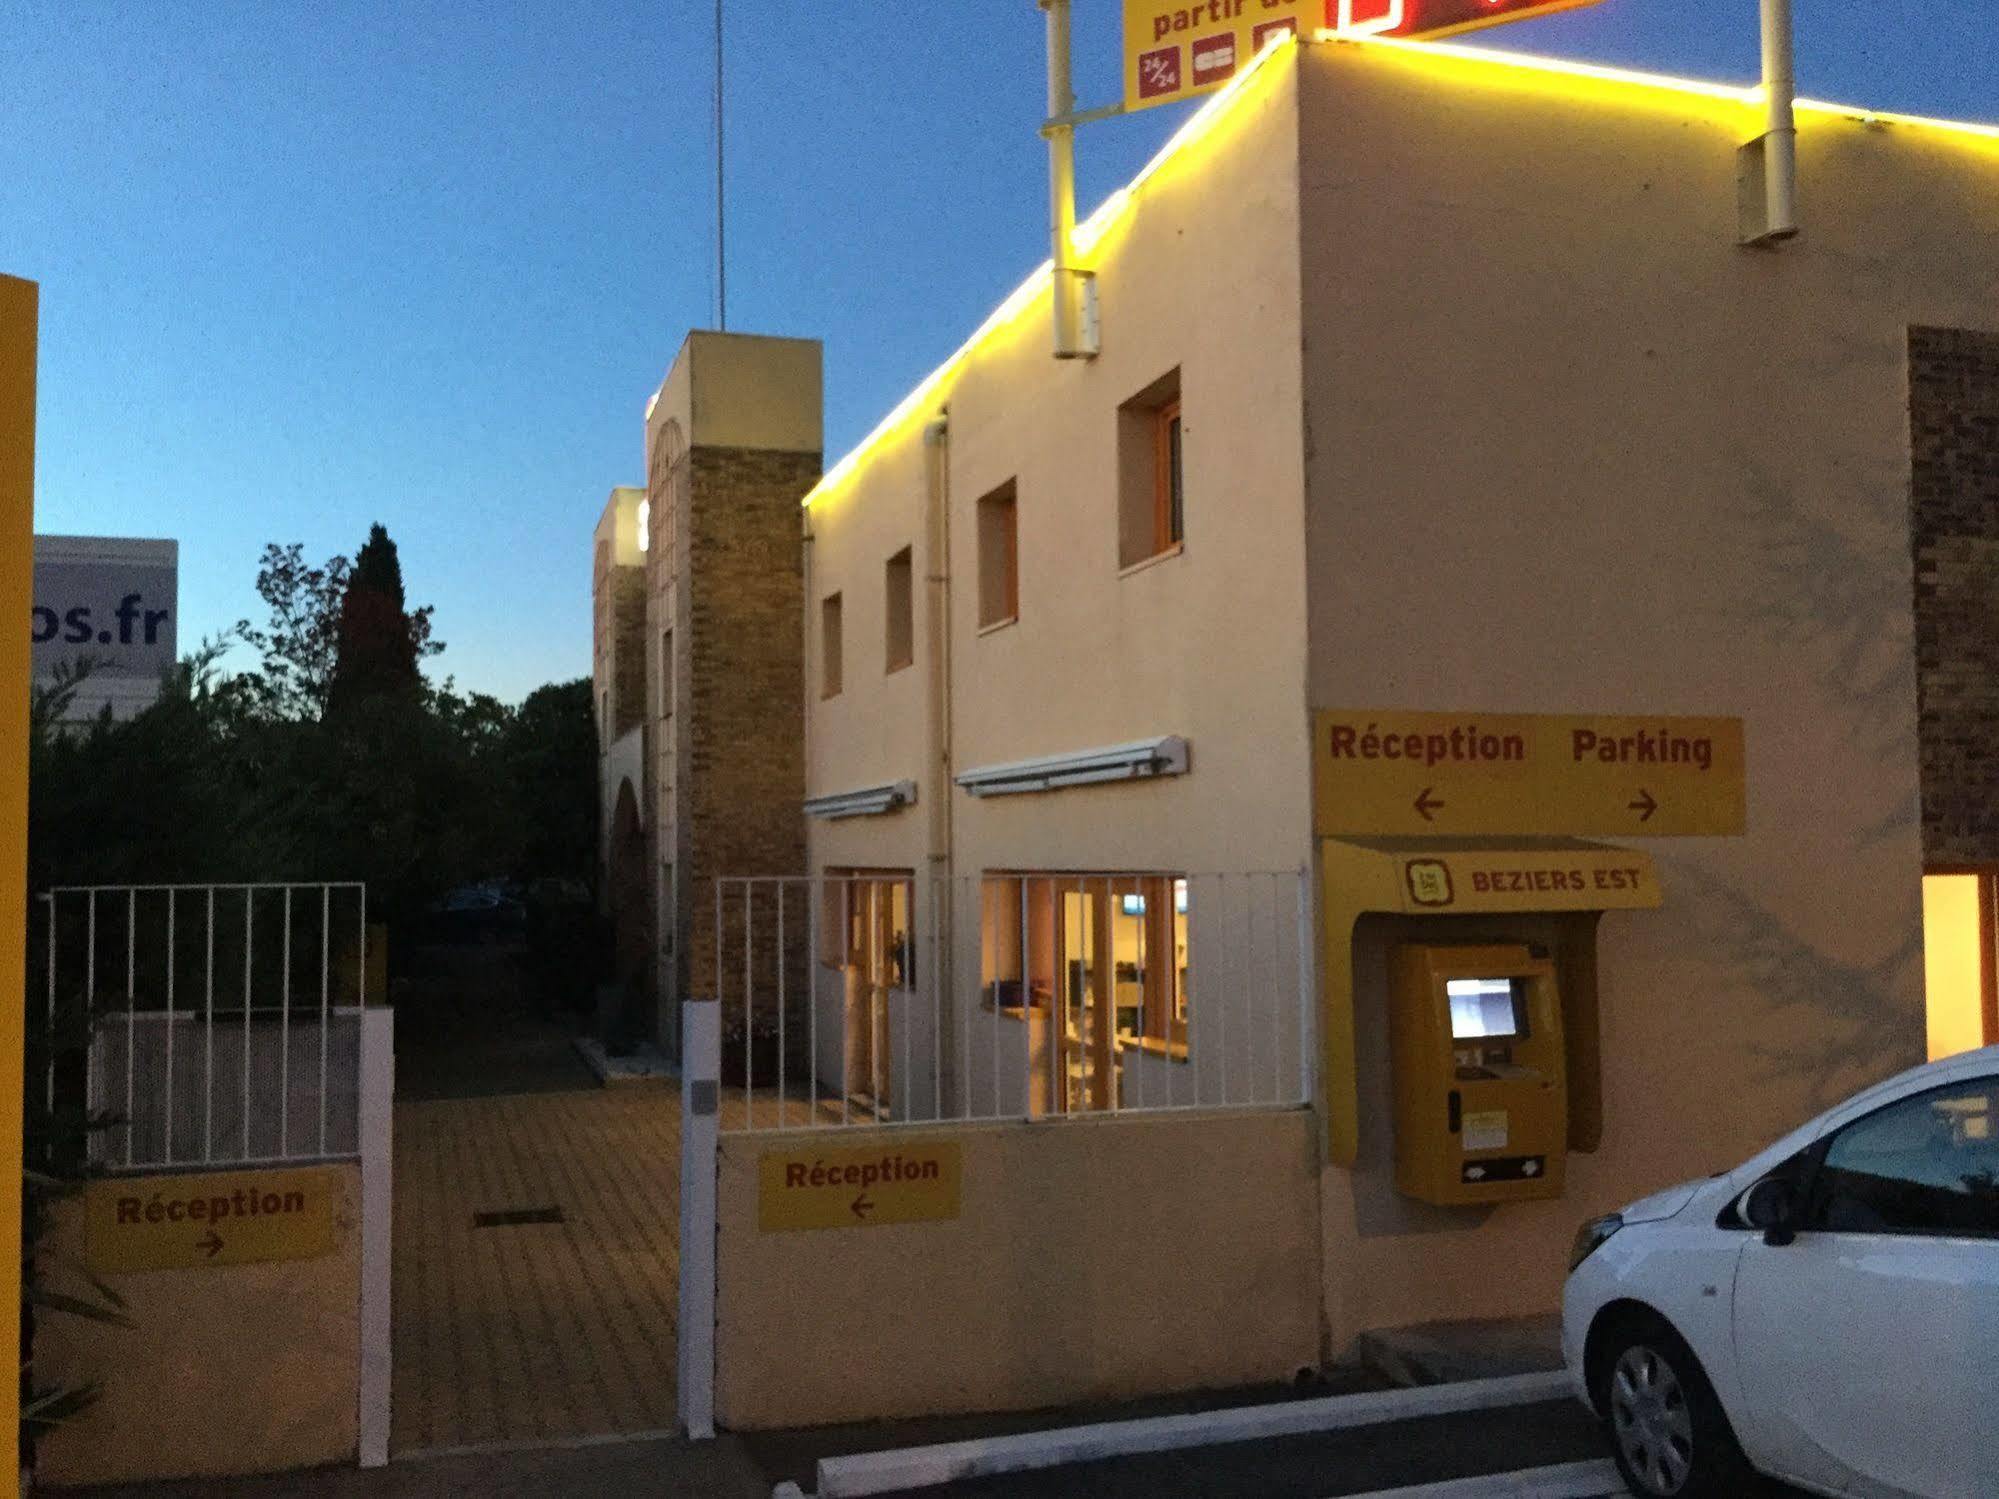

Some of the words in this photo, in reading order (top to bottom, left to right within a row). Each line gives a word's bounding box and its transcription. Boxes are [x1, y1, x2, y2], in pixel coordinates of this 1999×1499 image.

[1152, 0, 1243, 41] partir
[1331, 723, 1524, 768] Réception
[1573, 728, 1712, 771] Parking
[1473, 869, 1586, 892] BEZIERS
[1594, 868, 1641, 890] EST
[785, 1153, 939, 1188] Réception
[116, 1186, 304, 1226] Réception
